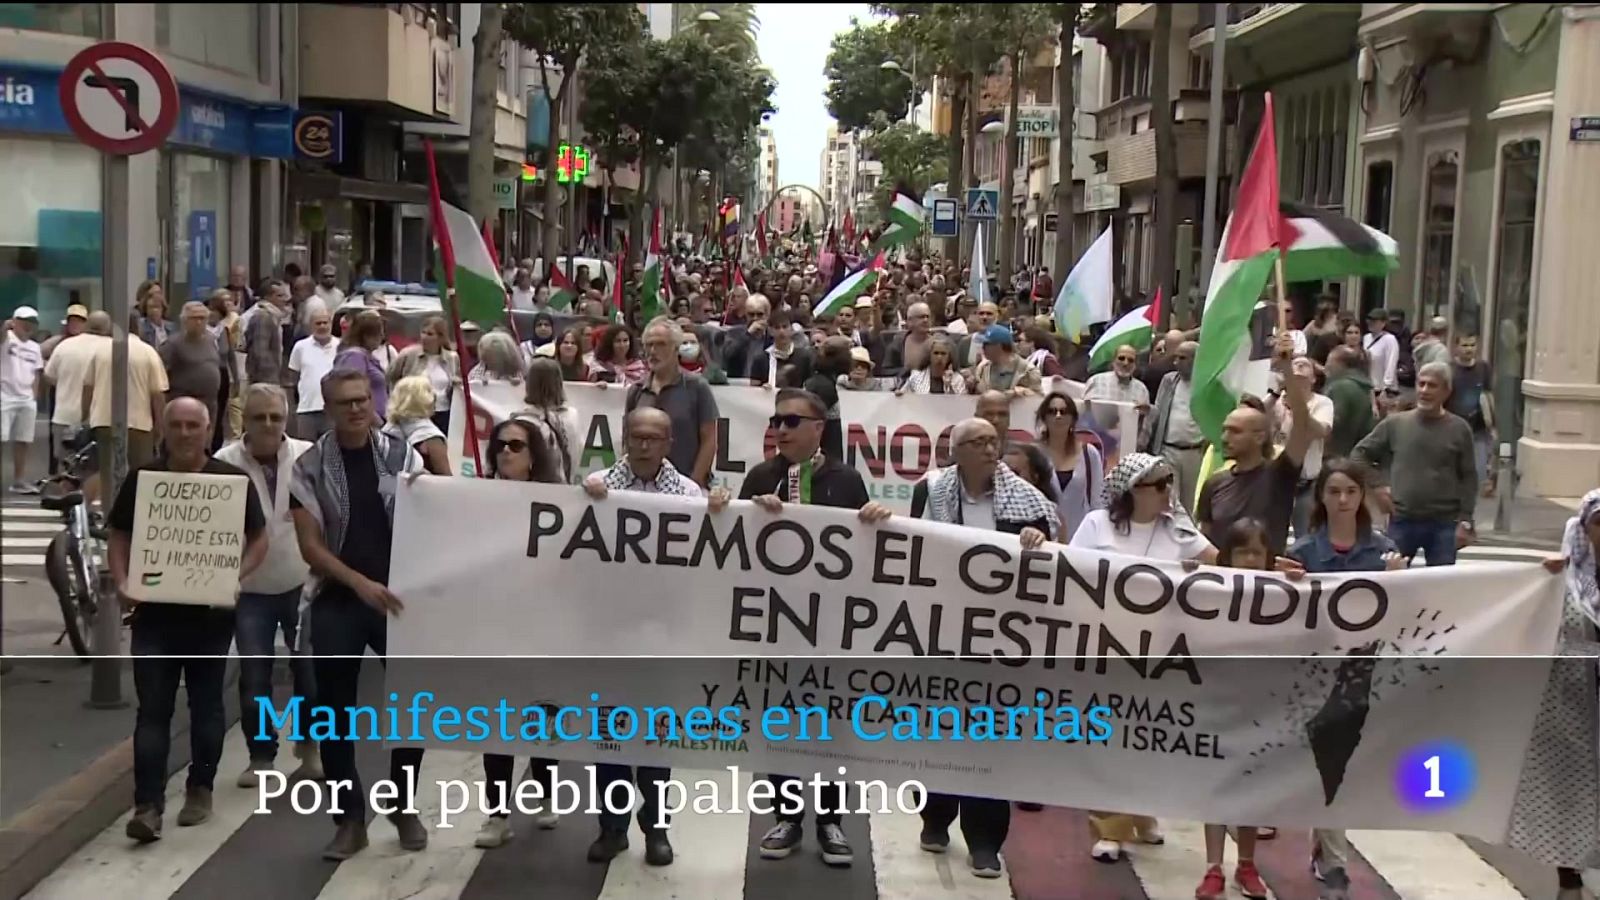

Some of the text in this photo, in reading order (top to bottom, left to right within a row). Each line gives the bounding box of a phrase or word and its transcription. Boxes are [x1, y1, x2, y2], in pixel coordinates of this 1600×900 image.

[305, 126, 329, 140] 24
[154, 481, 233, 501] QUERIDO
[789, 470, 800, 503] TINE
[148, 502, 212, 523] MUNDO
[147, 525, 240, 547] DONDE ESTA
[142, 549, 239, 569] TU HUMANIDAD
[526, 501, 1389, 632] PAREMOS EL GENOCIDIO
[729, 586, 1203, 686] EN PALESTINA
[737, 659, 1195, 728] FIN AL COMERCIO DE ARMAS
[701, 683, 720, 708] Y
[730, 685, 751, 711] A
[763, 687, 817, 717] LAS
[1121, 725, 1226, 760] ISRAEL
